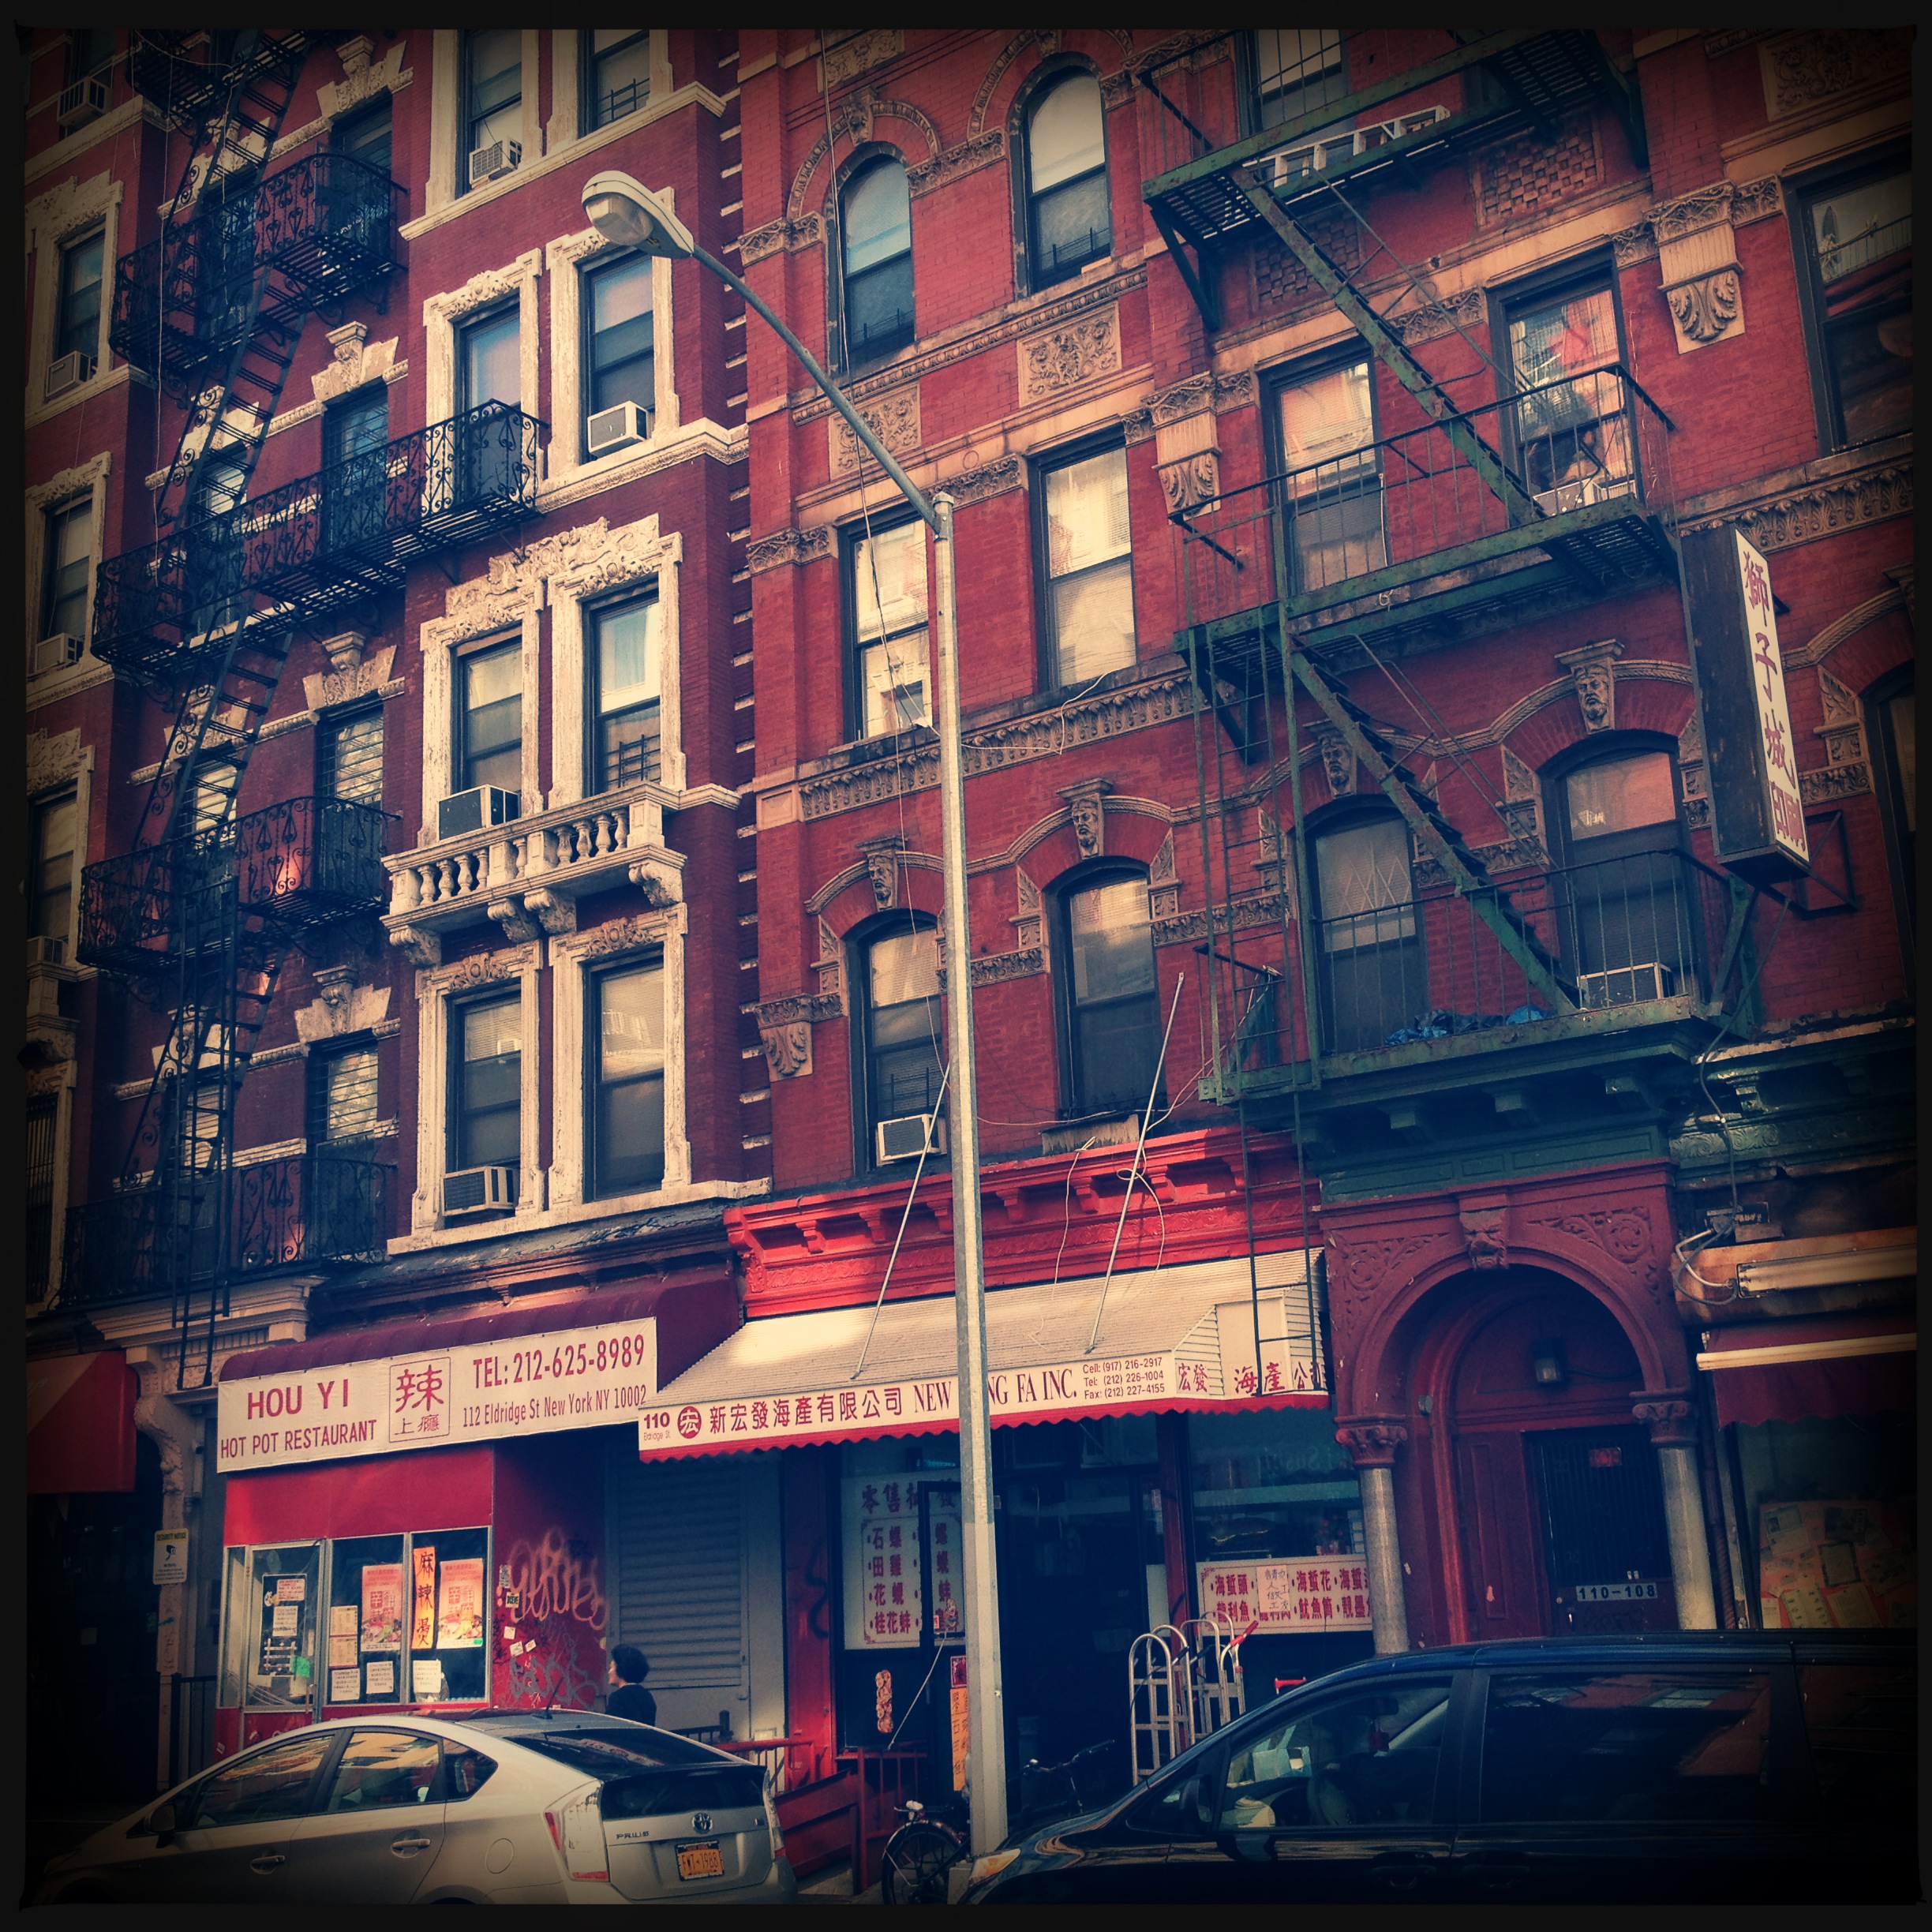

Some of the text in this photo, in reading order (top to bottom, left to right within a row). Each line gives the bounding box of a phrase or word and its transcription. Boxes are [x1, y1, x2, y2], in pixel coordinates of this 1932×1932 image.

[473, 1334, 645, 1389] TEL: 212-625-8989
[1082, 1357, 1163, 1374] Cell: (917) 216-2917
[1083, 1369, 1164, 1387] Tel: (212) 226-1004
[247, 1384, 302, 1420] HOU
[395, 1363, 444, 1413] 辣
[462, 1384, 646, 1428] 112 Eldridge St New York NY 10002
[913, 1381, 952, 1413] NEW
[1017, 1372, 1037, 1403] FA
[1043, 1368, 1077, 1401] INC.
[1084, 1383, 1165, 1399] Fax: (212) 227-4155
[643, 1411, 671, 1429] 110
[710, 1386, 903, 1435] 新宏發海產有限公司
[220, 1419, 377, 1459] HOT POT RESTAURANT
[1578, 1582, 1656, 1600] 110-108
[616, 1830, 650, 1840] PRIUS
